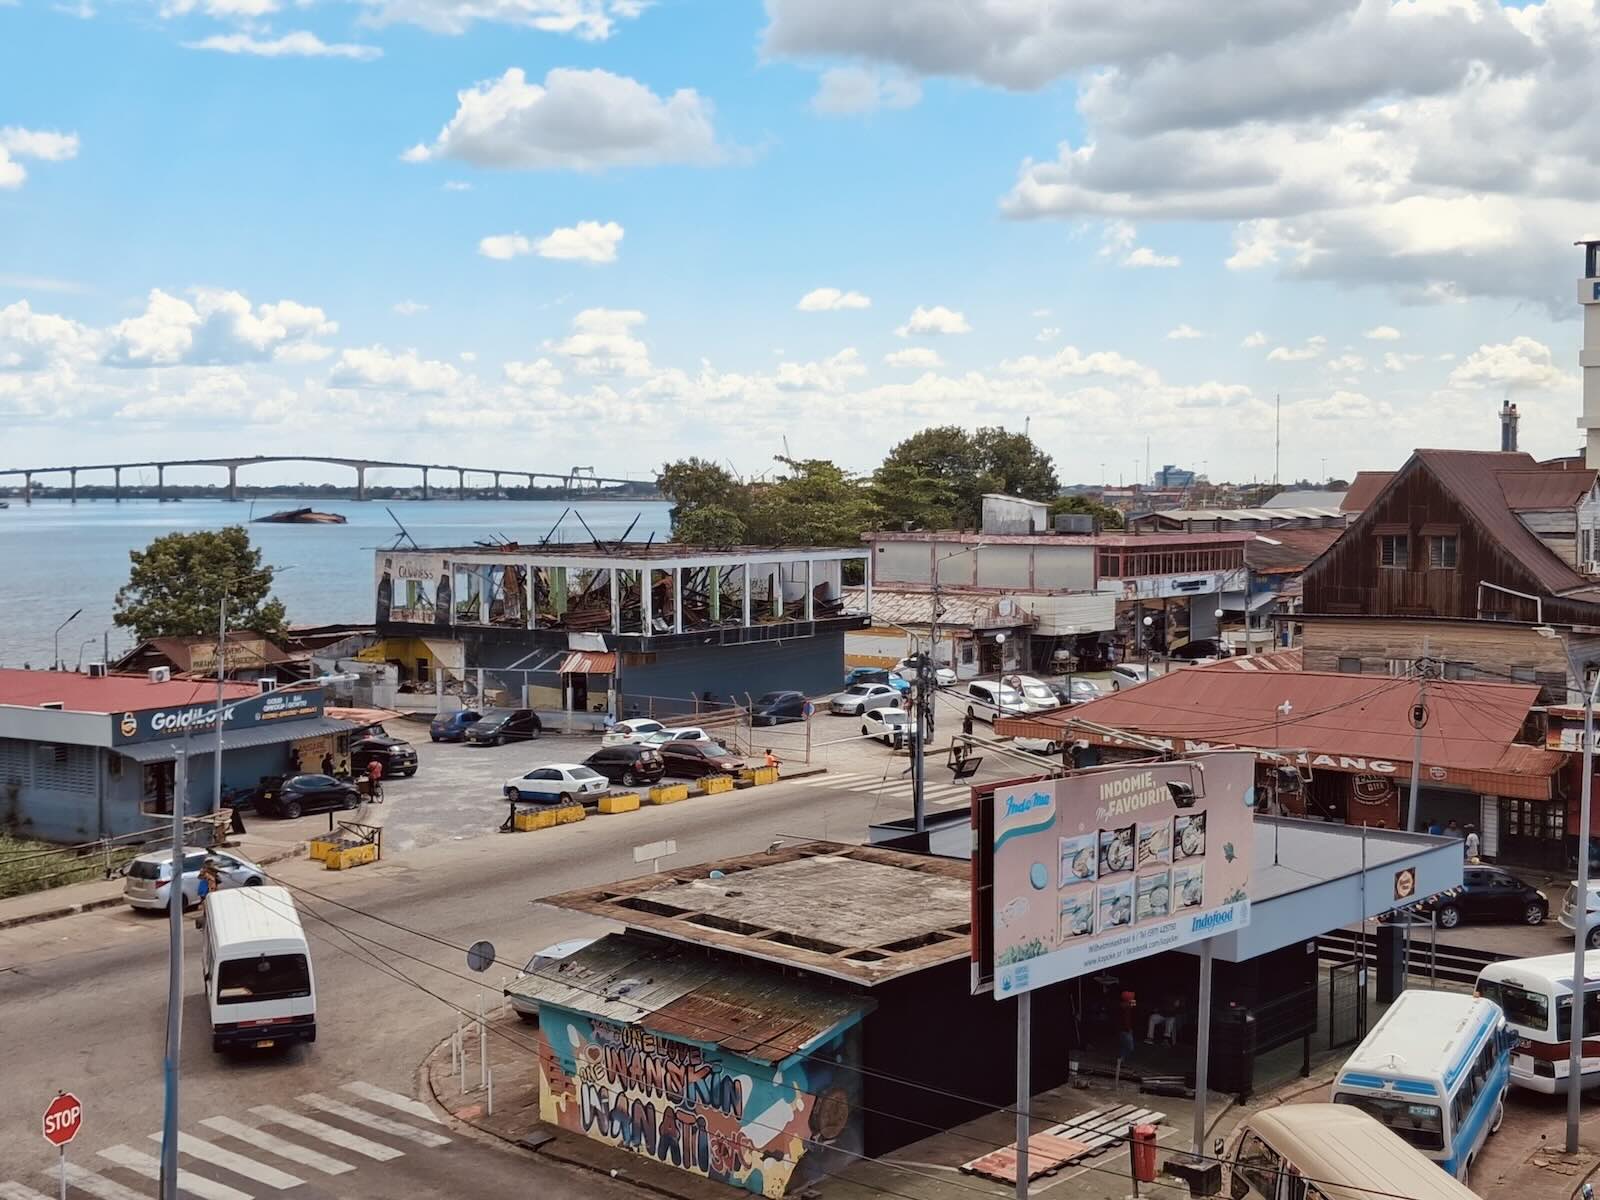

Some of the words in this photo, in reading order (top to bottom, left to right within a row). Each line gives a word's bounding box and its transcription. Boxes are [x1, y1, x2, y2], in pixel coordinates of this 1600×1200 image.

[151, 705, 235, 731] GoldiLok
[1192, 906, 1234, 932] Indofood
[46, 1105, 80, 1134] STOP
